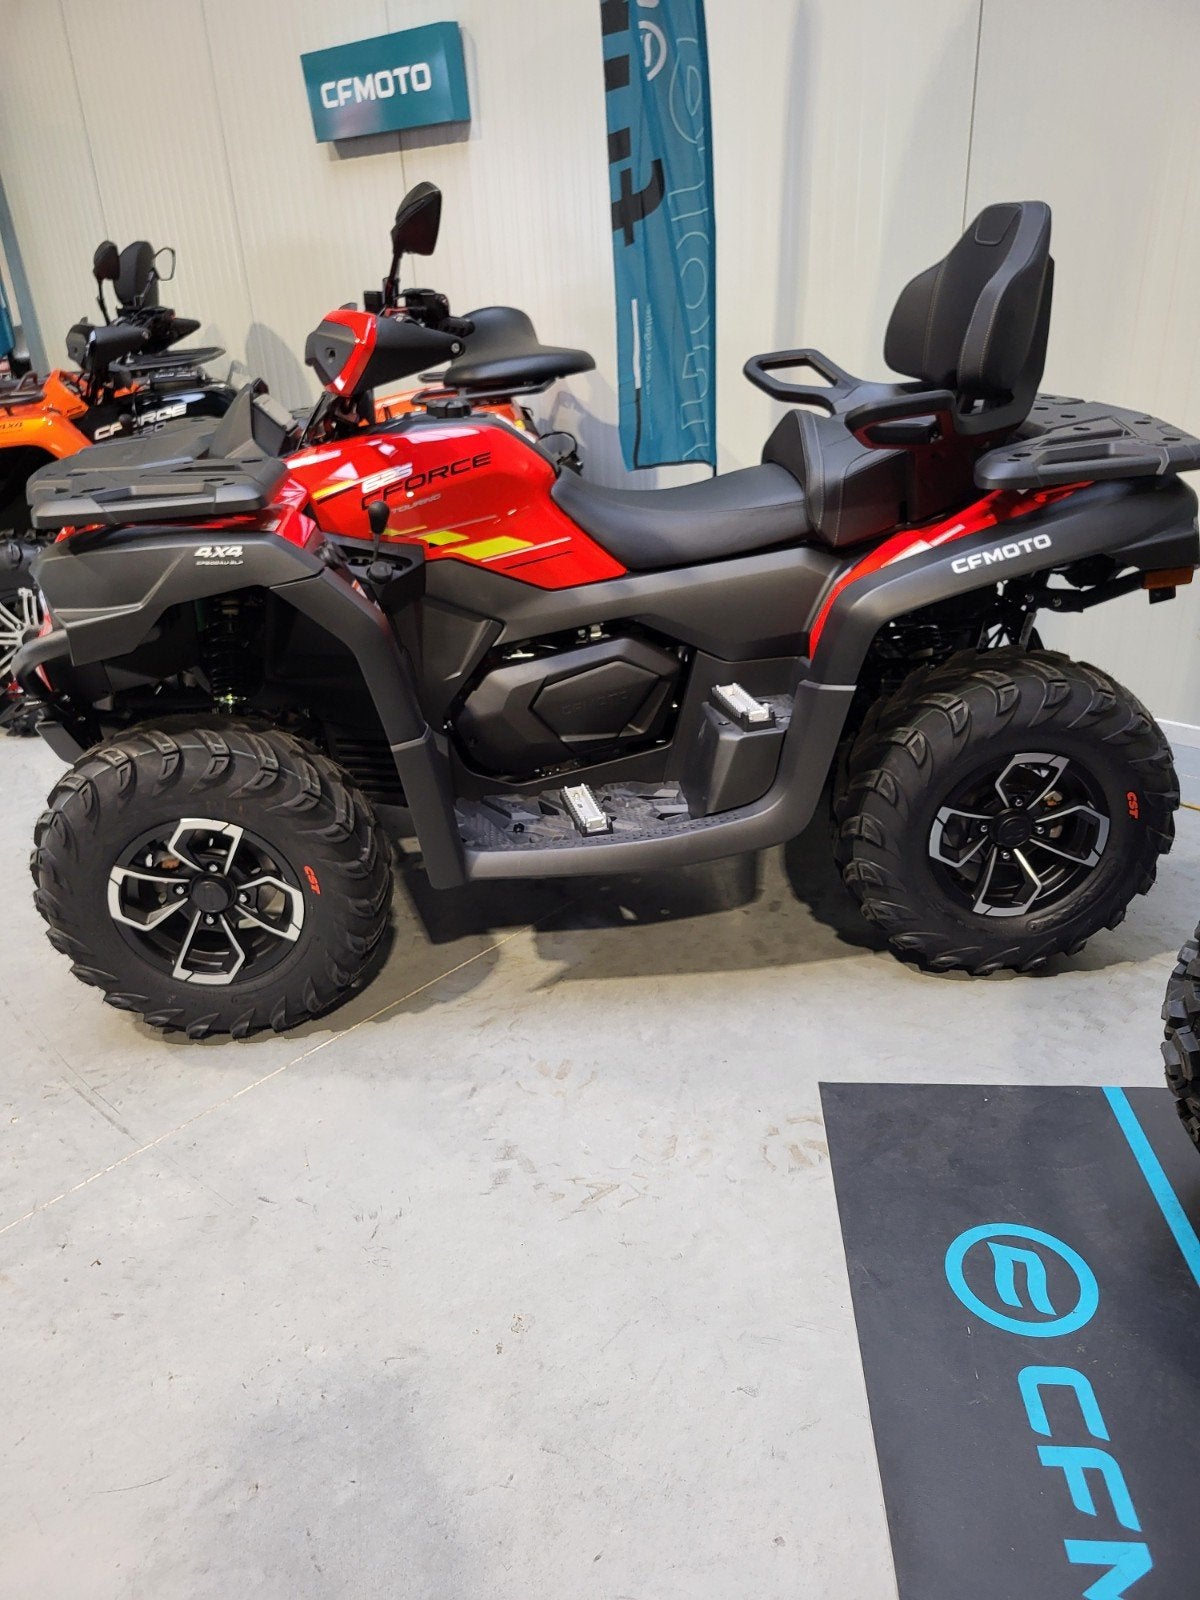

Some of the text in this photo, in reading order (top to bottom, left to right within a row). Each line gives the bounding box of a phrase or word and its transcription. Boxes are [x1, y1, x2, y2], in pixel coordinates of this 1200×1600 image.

[320, 62, 432, 109] CFMOTO
[94, 402, 187, 441] CFRCE
[361, 451, 491, 511] CFORCE
[950, 533, 1052, 574] CFMOTO
[1126, 791, 1139, 820] CST
[303, 865, 321, 895] CST
